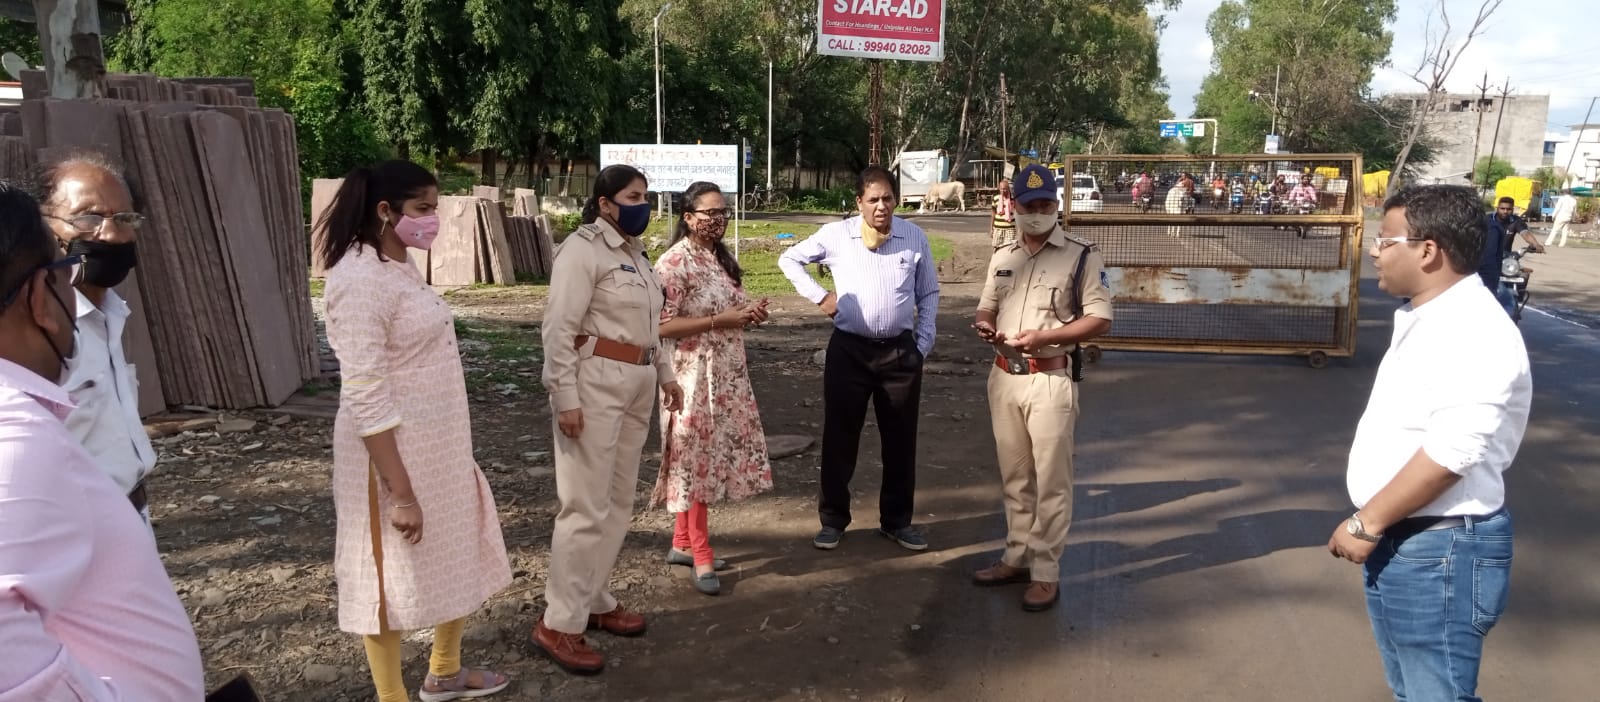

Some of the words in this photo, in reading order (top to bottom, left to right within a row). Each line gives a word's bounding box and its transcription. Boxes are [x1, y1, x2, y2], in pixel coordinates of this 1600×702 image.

[833, 0, 929, 19] STAR-AD
[828, 38, 855, 50] CALL
[863, 41, 897, 53] 99940
[898, 43, 932, 55] 82082
